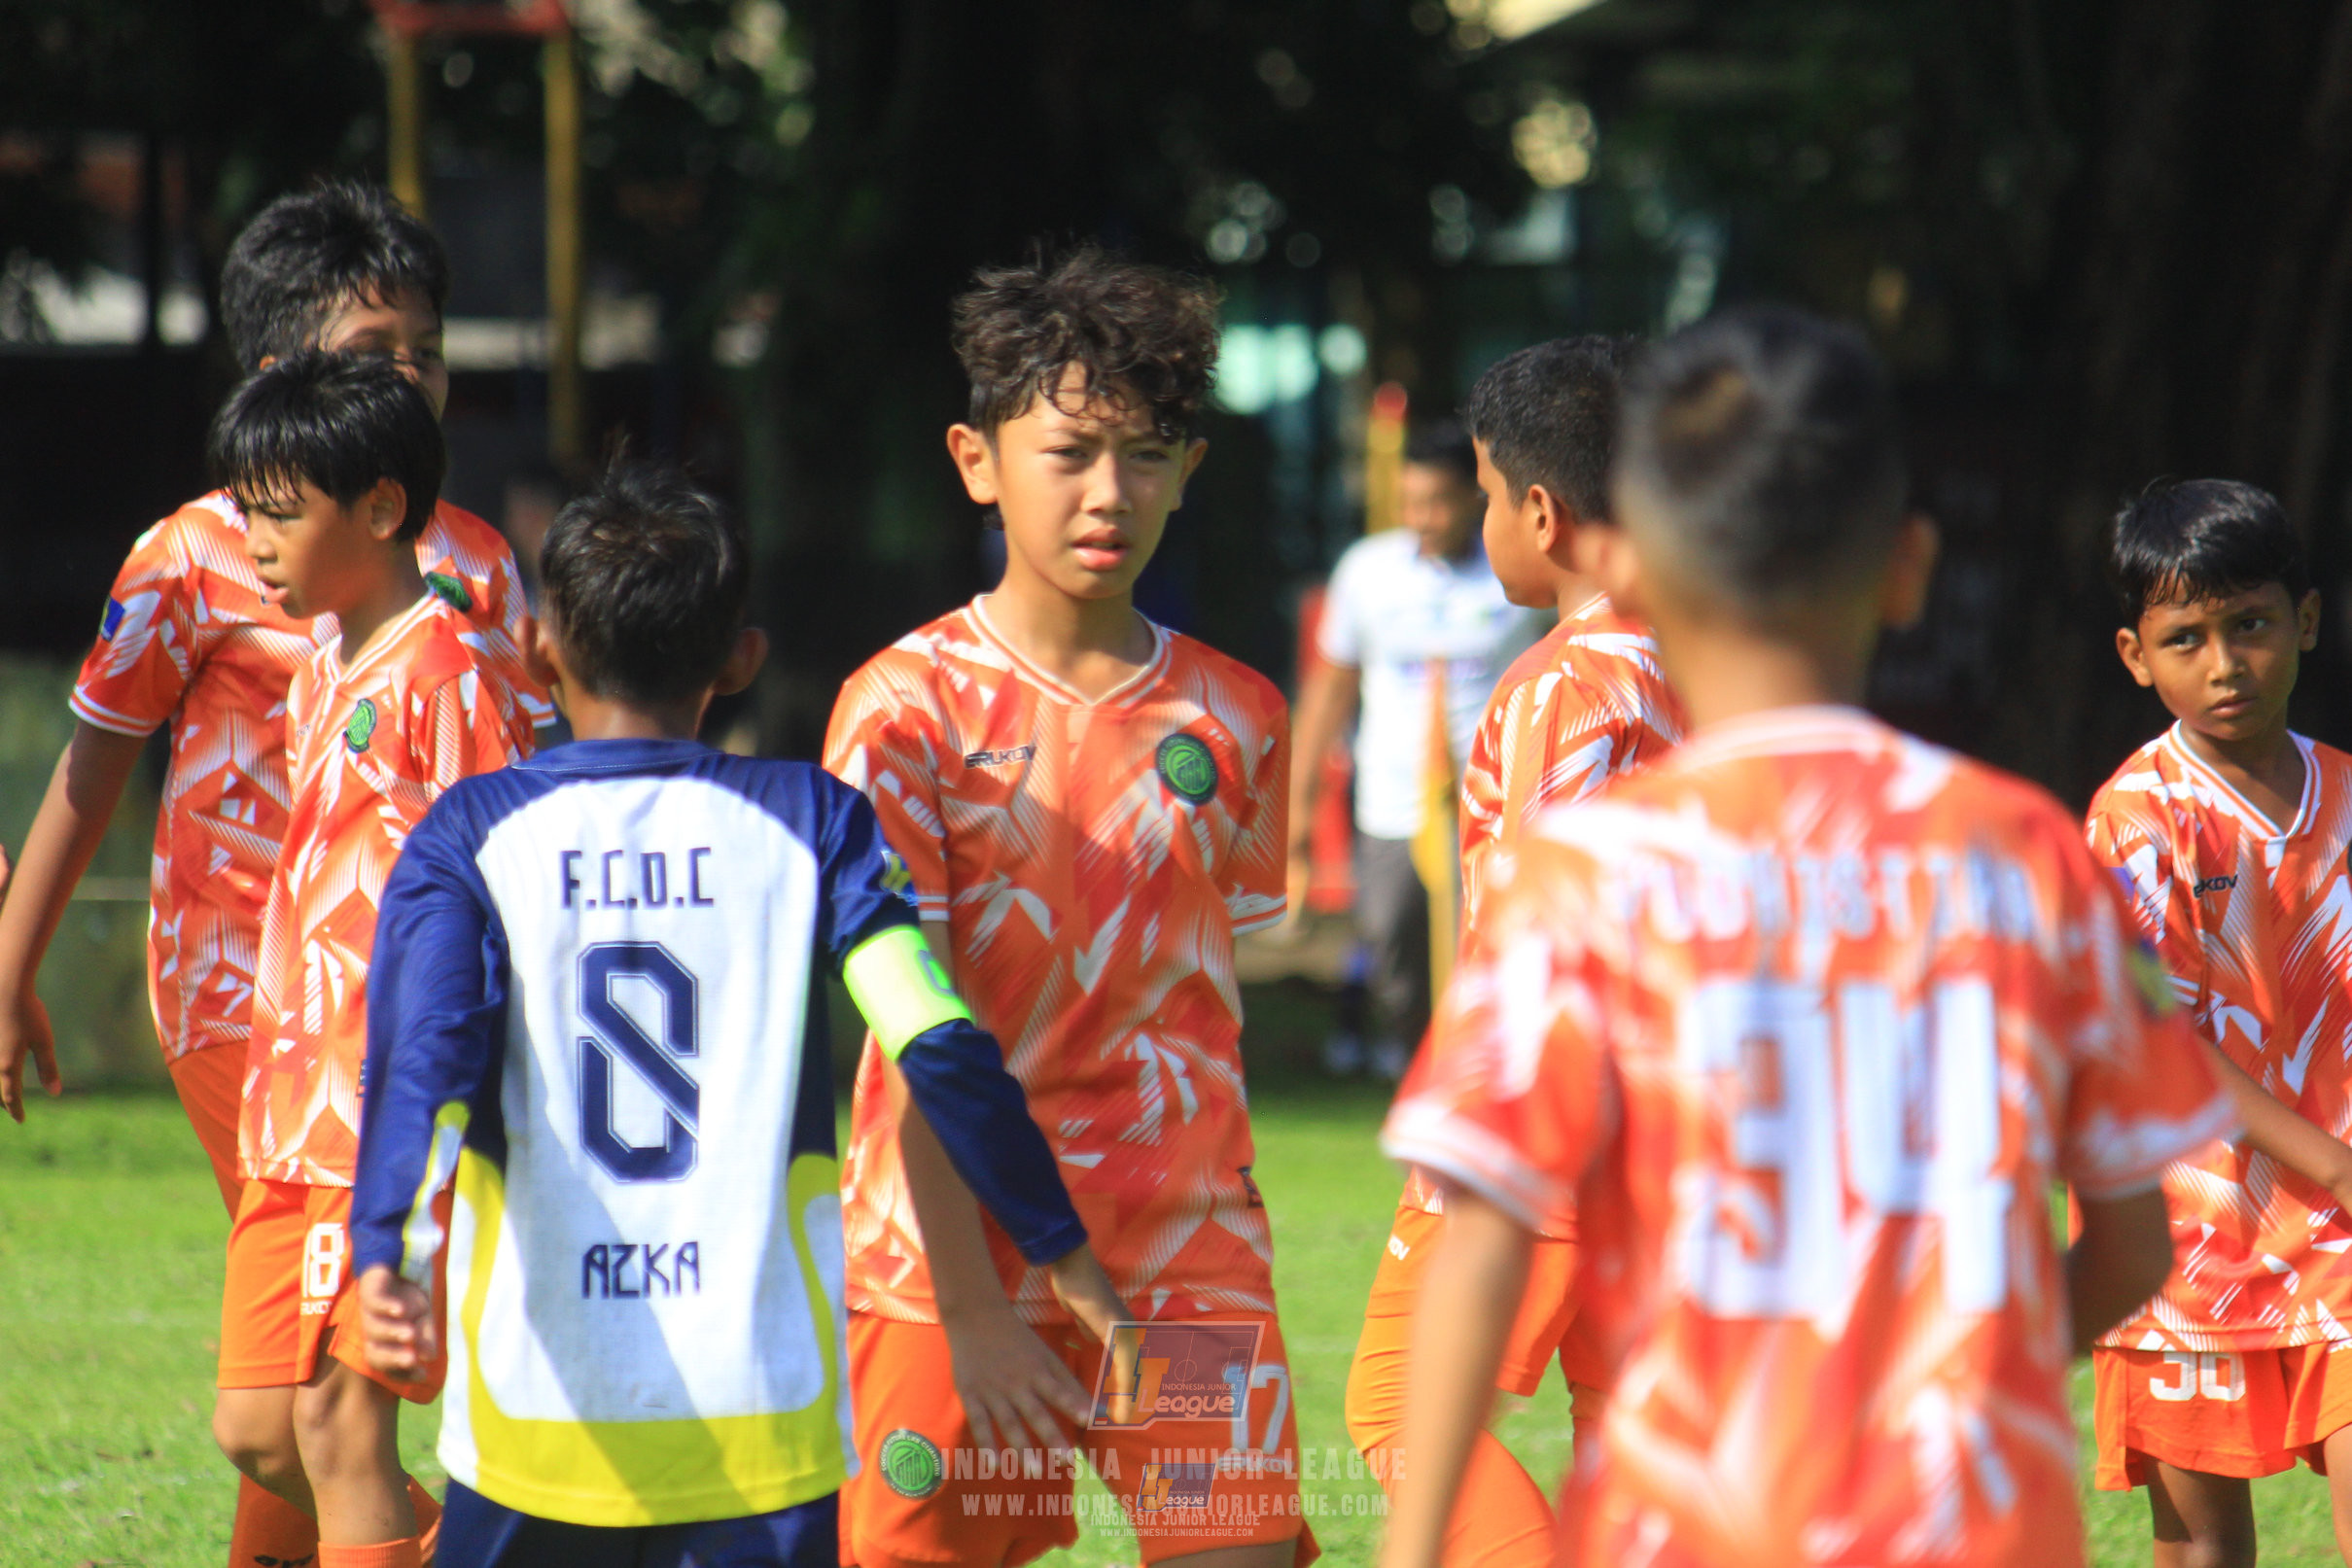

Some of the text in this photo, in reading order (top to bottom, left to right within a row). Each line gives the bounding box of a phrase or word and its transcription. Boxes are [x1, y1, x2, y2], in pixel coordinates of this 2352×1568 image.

[577, 941, 699, 1185] 8
[1684, 977, 2015, 1318] 34
[581, 1241, 701, 1299] AZKA
